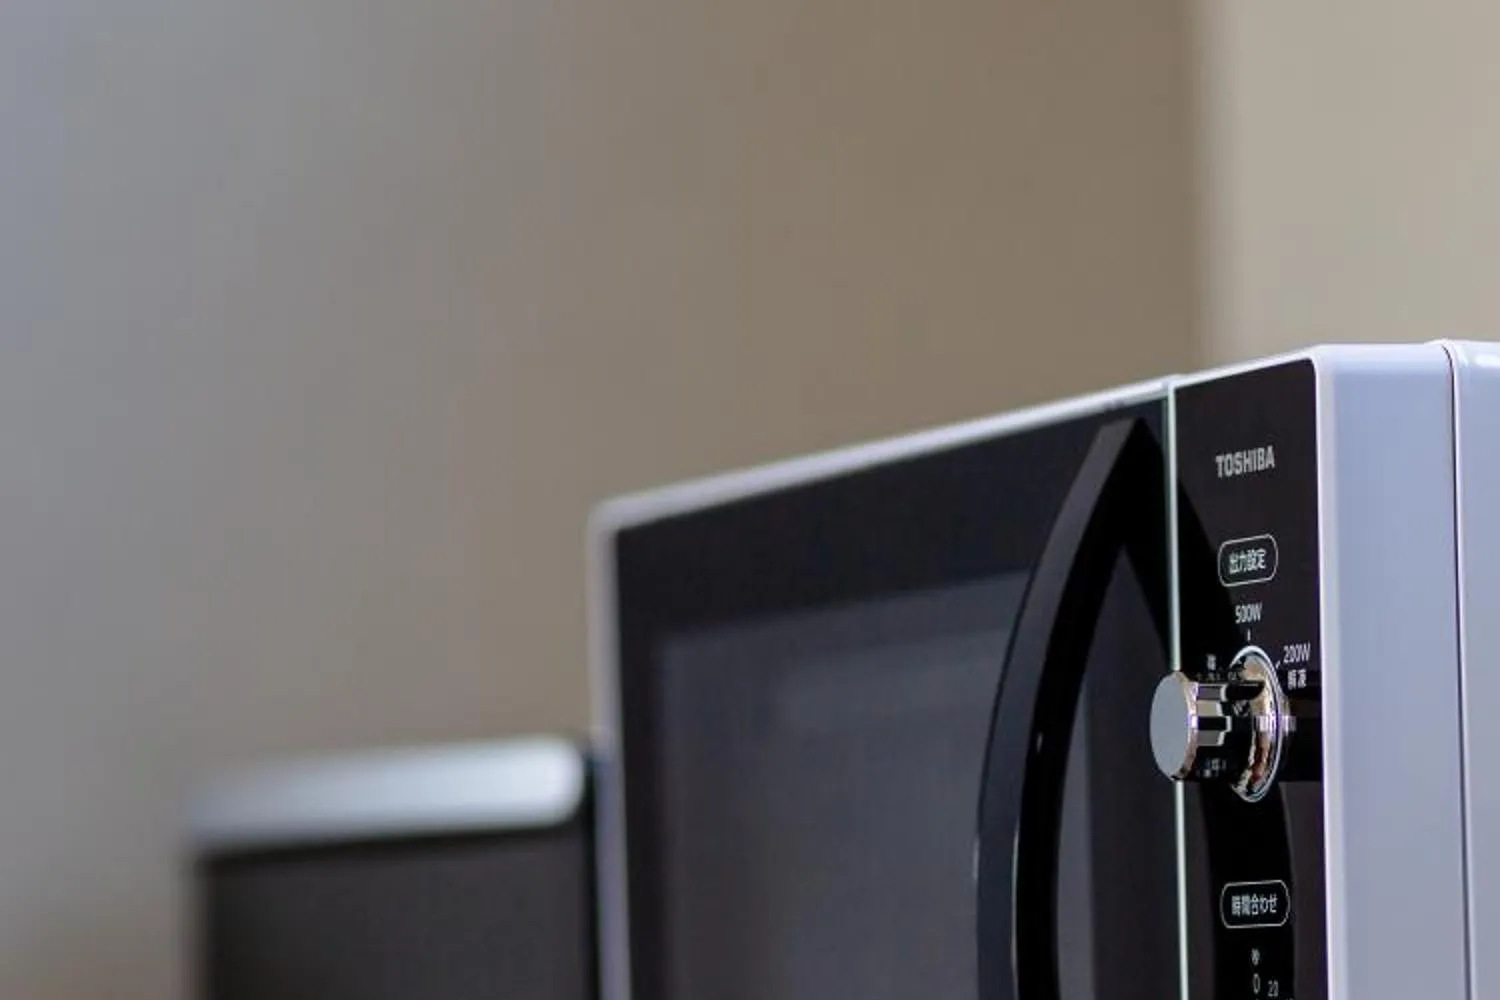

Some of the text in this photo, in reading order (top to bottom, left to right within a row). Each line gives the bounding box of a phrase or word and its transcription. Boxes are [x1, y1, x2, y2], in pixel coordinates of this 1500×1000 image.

[1215, 445, 1276, 478] TOSHIBA
[1228, 548, 1267, 575] 出力設定
[1235, 602, 1263, 624] 500W
[1283, 642, 1311, 665] 200W
[1267, 979, 1280, 998] 20
